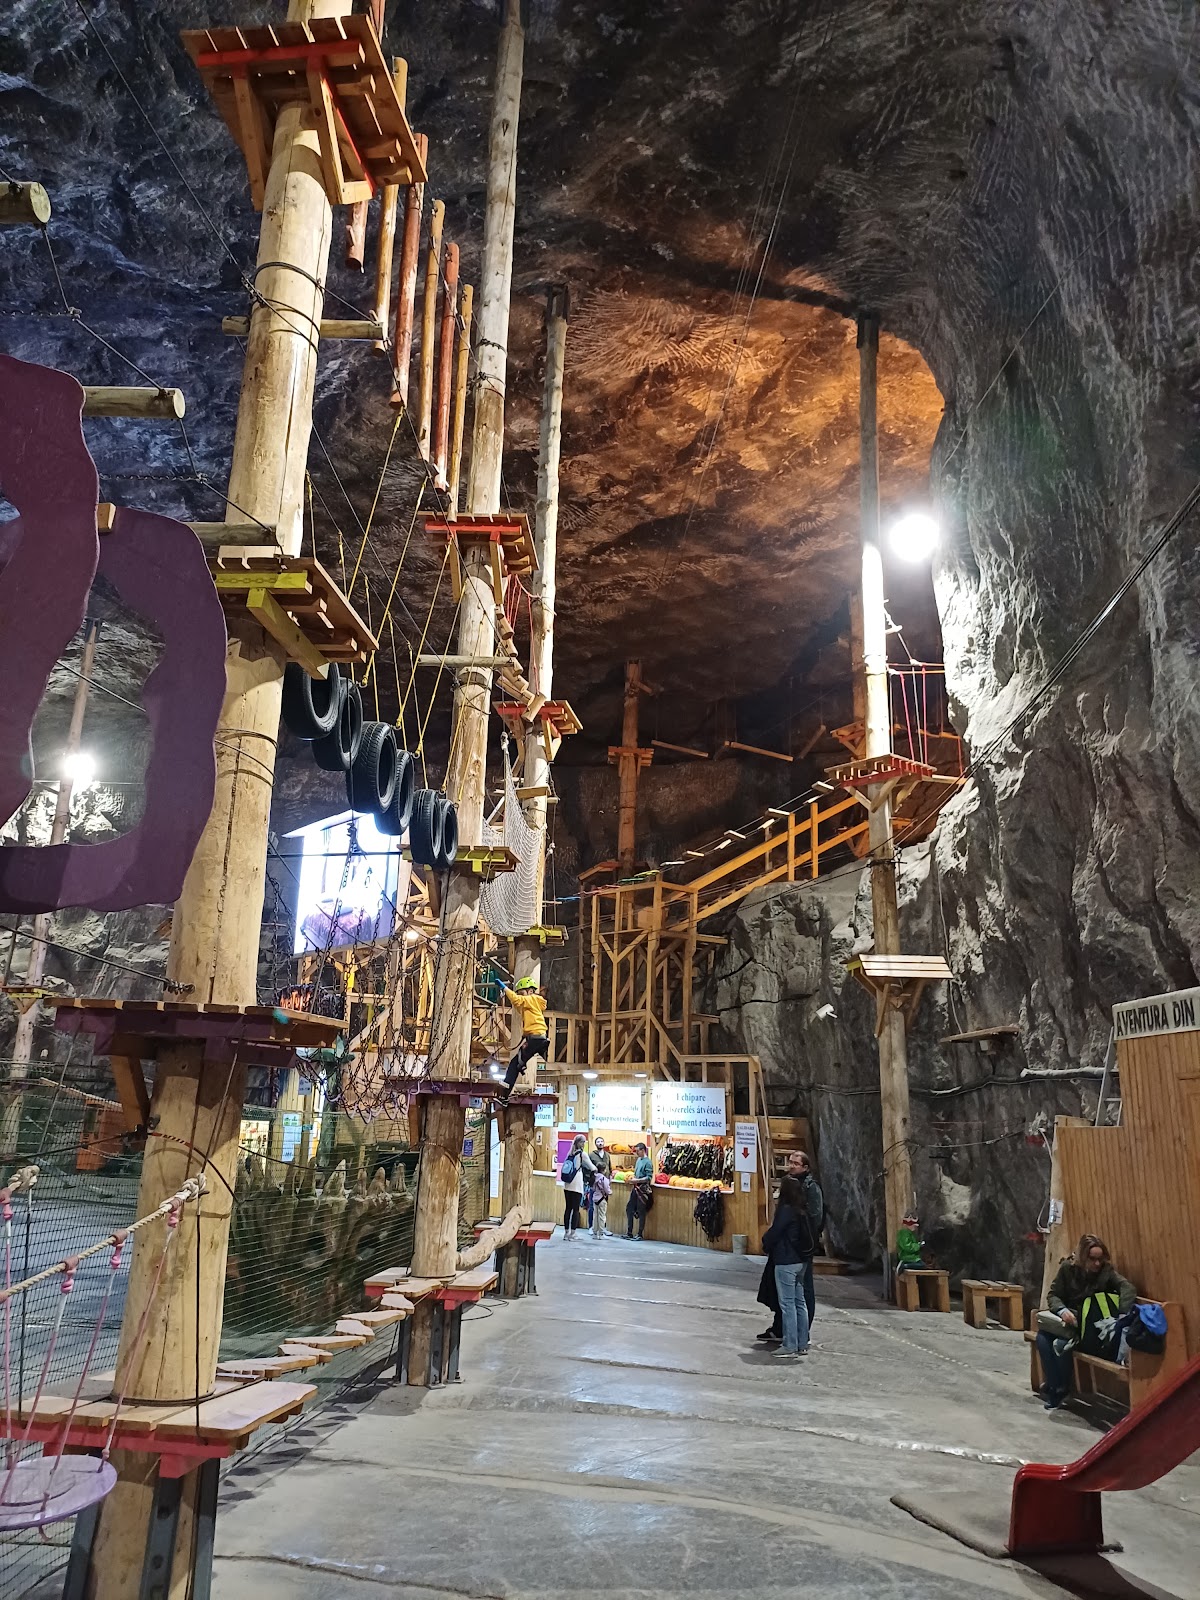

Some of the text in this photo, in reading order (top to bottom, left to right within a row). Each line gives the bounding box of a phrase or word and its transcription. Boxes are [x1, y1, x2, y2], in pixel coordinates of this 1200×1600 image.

[1117, 998, 1195, 1037] AVENTURA DIN
[697, 1105, 722, 1115] átvétele
[699, 1118, 722, 1128] release
